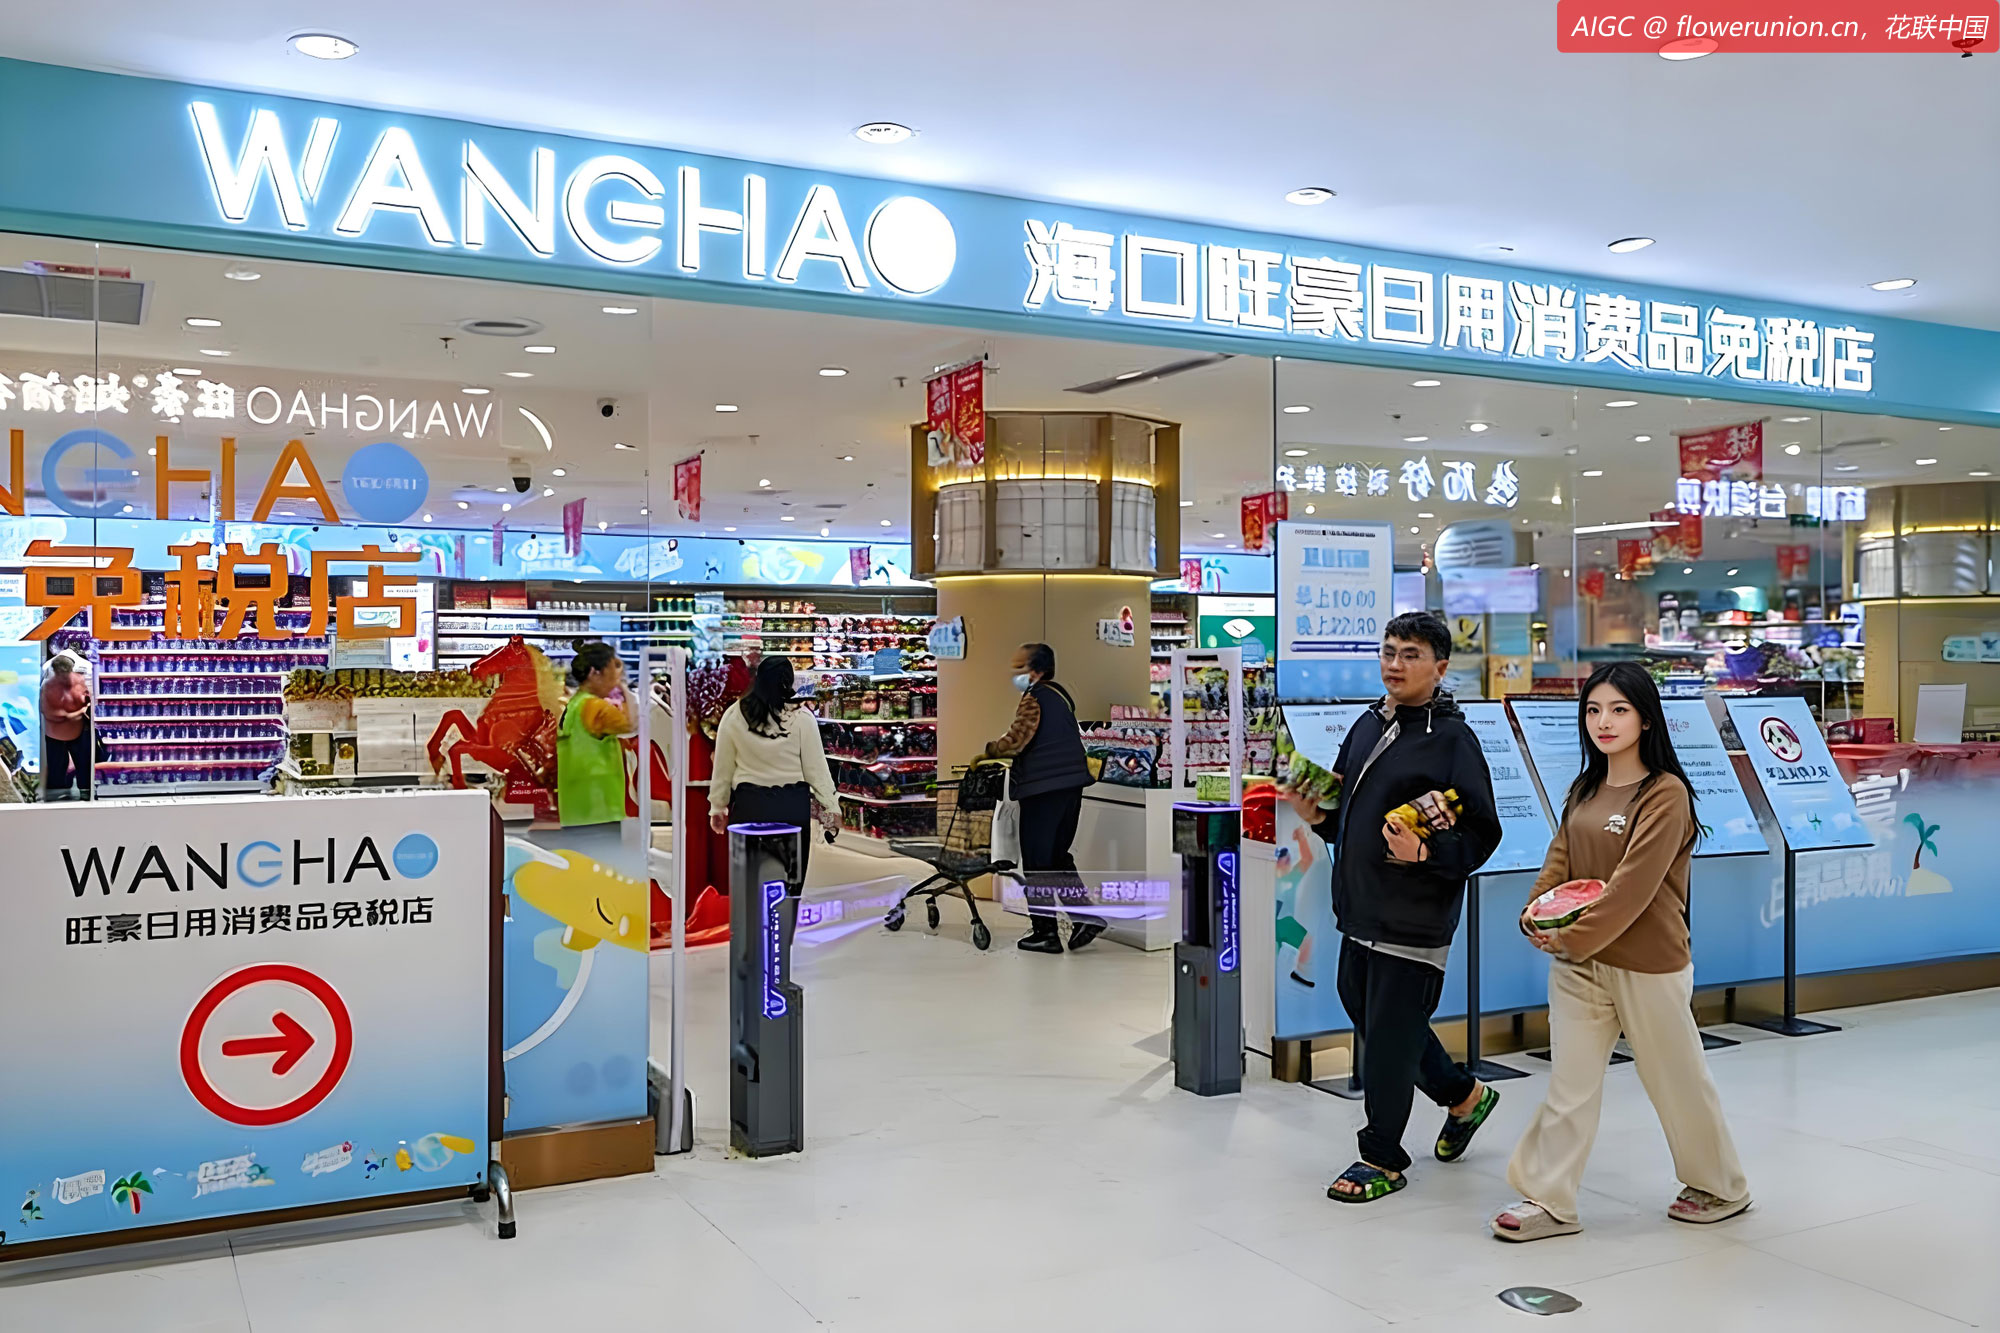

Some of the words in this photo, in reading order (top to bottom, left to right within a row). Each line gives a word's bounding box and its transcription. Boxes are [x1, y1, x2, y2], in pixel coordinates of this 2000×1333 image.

[189, 101, 957, 297] WANGHAO
[1022, 218, 1877, 394] 海口旺豪日用消费品免税店
[22, 538, 422, 642] 免税店
[60, 833, 439, 898] WANGHAO
[65, 896, 435, 946] 旺豪日用消费品免税店
